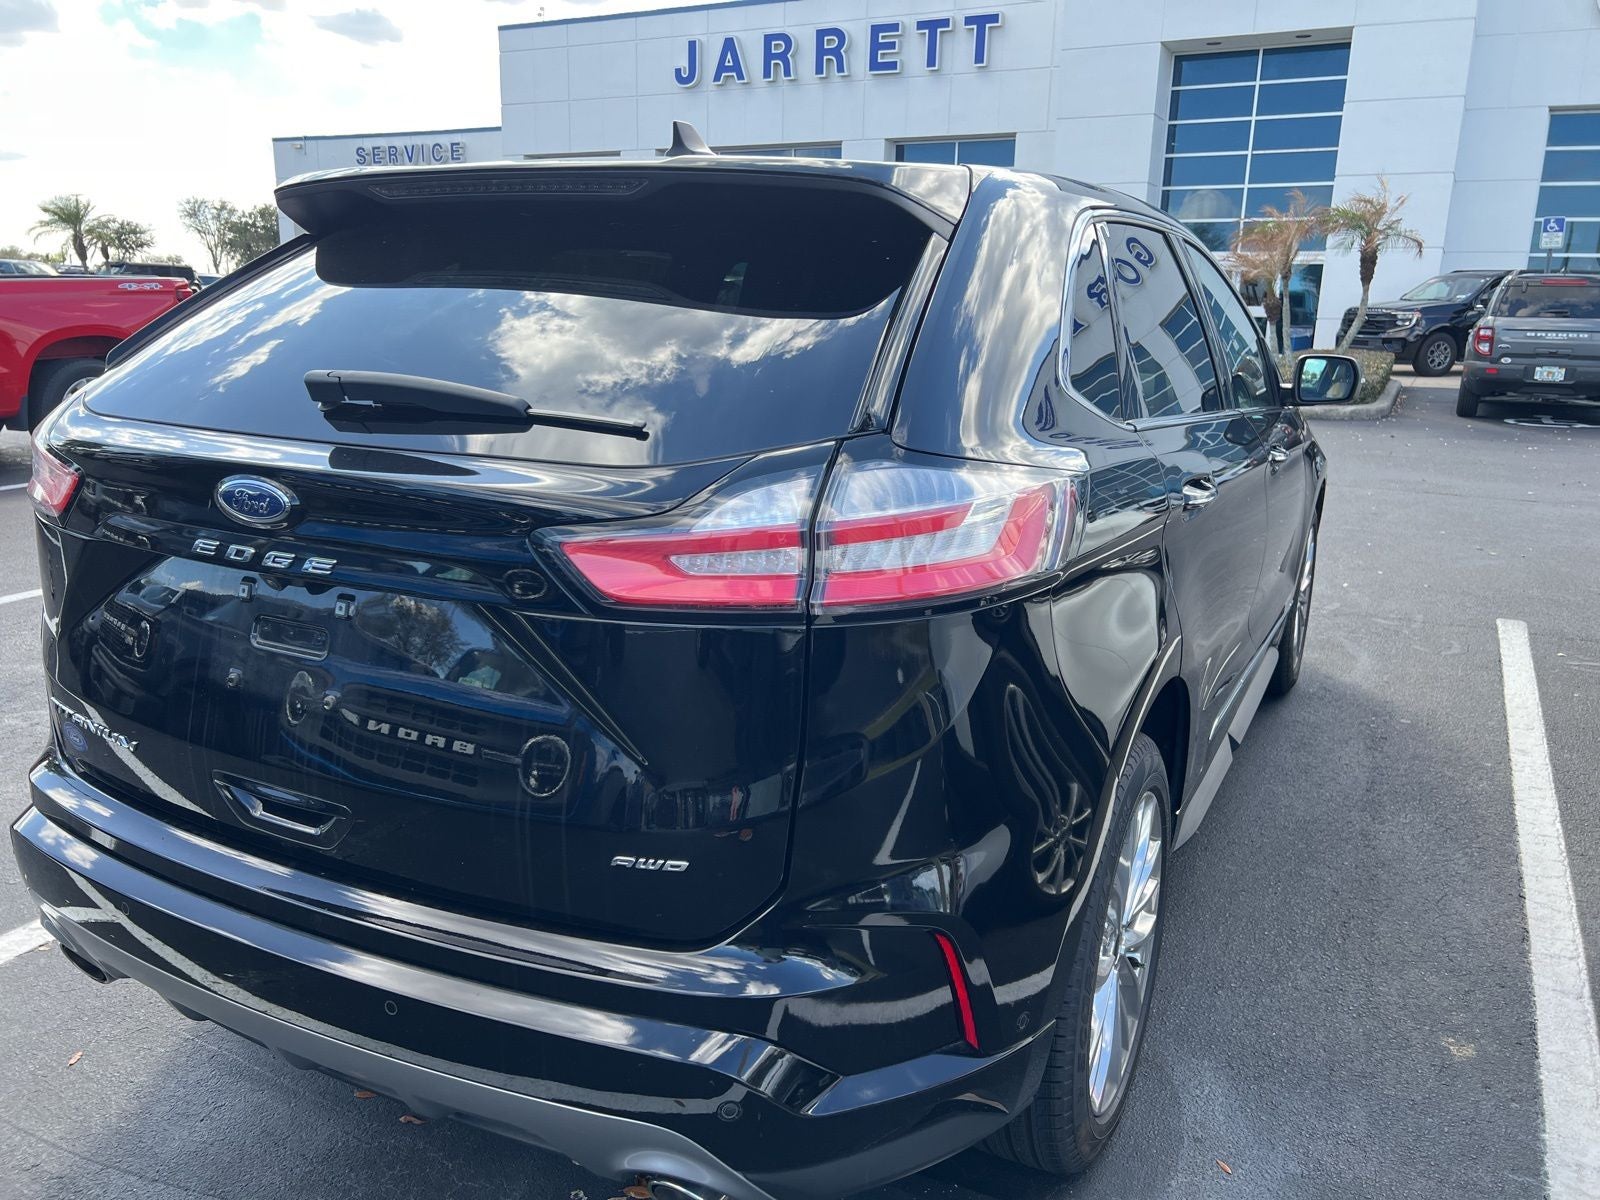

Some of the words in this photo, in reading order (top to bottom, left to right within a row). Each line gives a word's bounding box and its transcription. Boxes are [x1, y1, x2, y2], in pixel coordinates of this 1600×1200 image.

[673, 12, 1003, 88] JARRETT
[356, 142, 462, 165] SERVICE
[191, 538, 338, 576] EDGE
[610, 855, 690, 872] AWD
